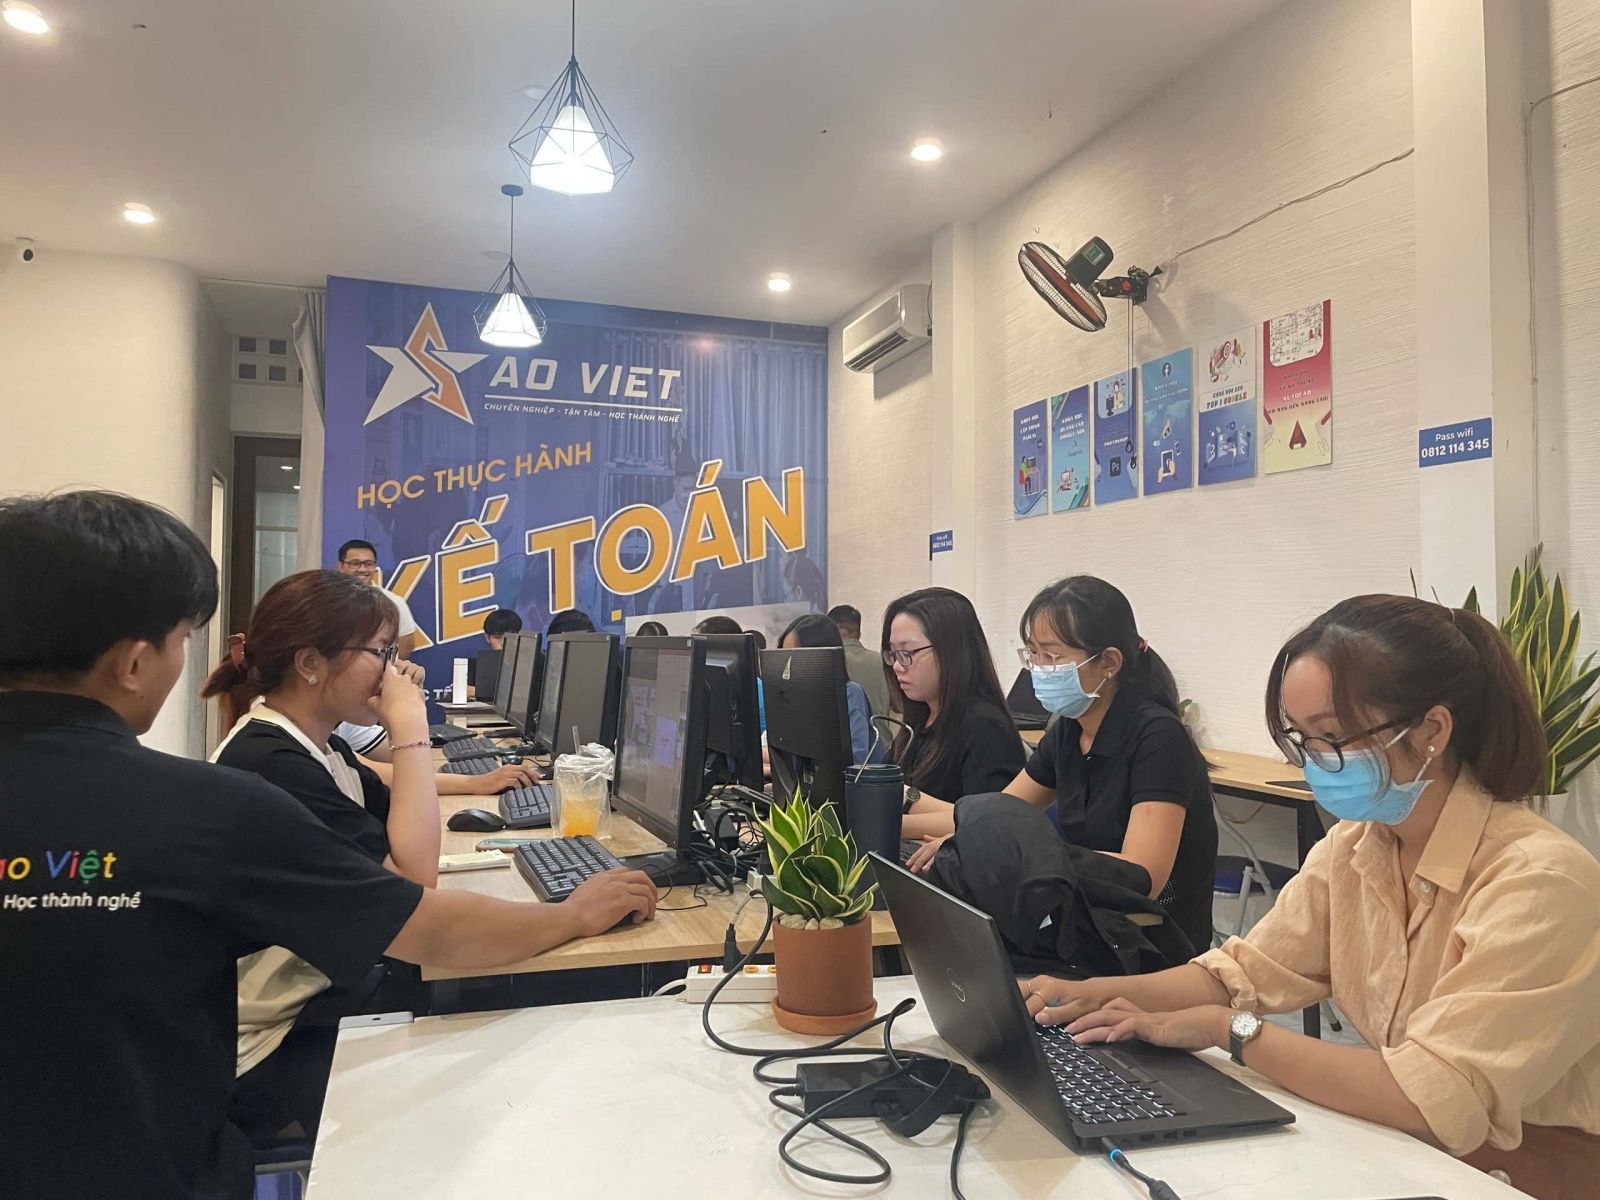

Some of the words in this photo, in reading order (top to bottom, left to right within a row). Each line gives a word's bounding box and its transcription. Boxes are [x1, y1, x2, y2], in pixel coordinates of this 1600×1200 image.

[484, 402, 520, 412] CHUYÊN
[522, 405, 555, 415] NGHIỆP
[563, 407, 580, 416] TẬN
[583, 408, 600, 417] TÂM
[608, 411, 626, 420] HỌC
[1435, 431, 1455, 442] Pass
[1456, 426, 1474, 439] wifi
[1421, 445, 1446, 458] 0812
[1449, 442, 1465, 454] 114
[1467, 438, 1490, 451] 345
[357, 474, 425, 509] HỌC
[434, 459, 506, 492] THỰC
[515, 440, 592, 477] HÀNH
[526, 459, 806, 614] TOÁN
[45, 849, 118, 884] Việt
[3, 894, 38, 911] Học
[42, 892, 92, 908] thành
